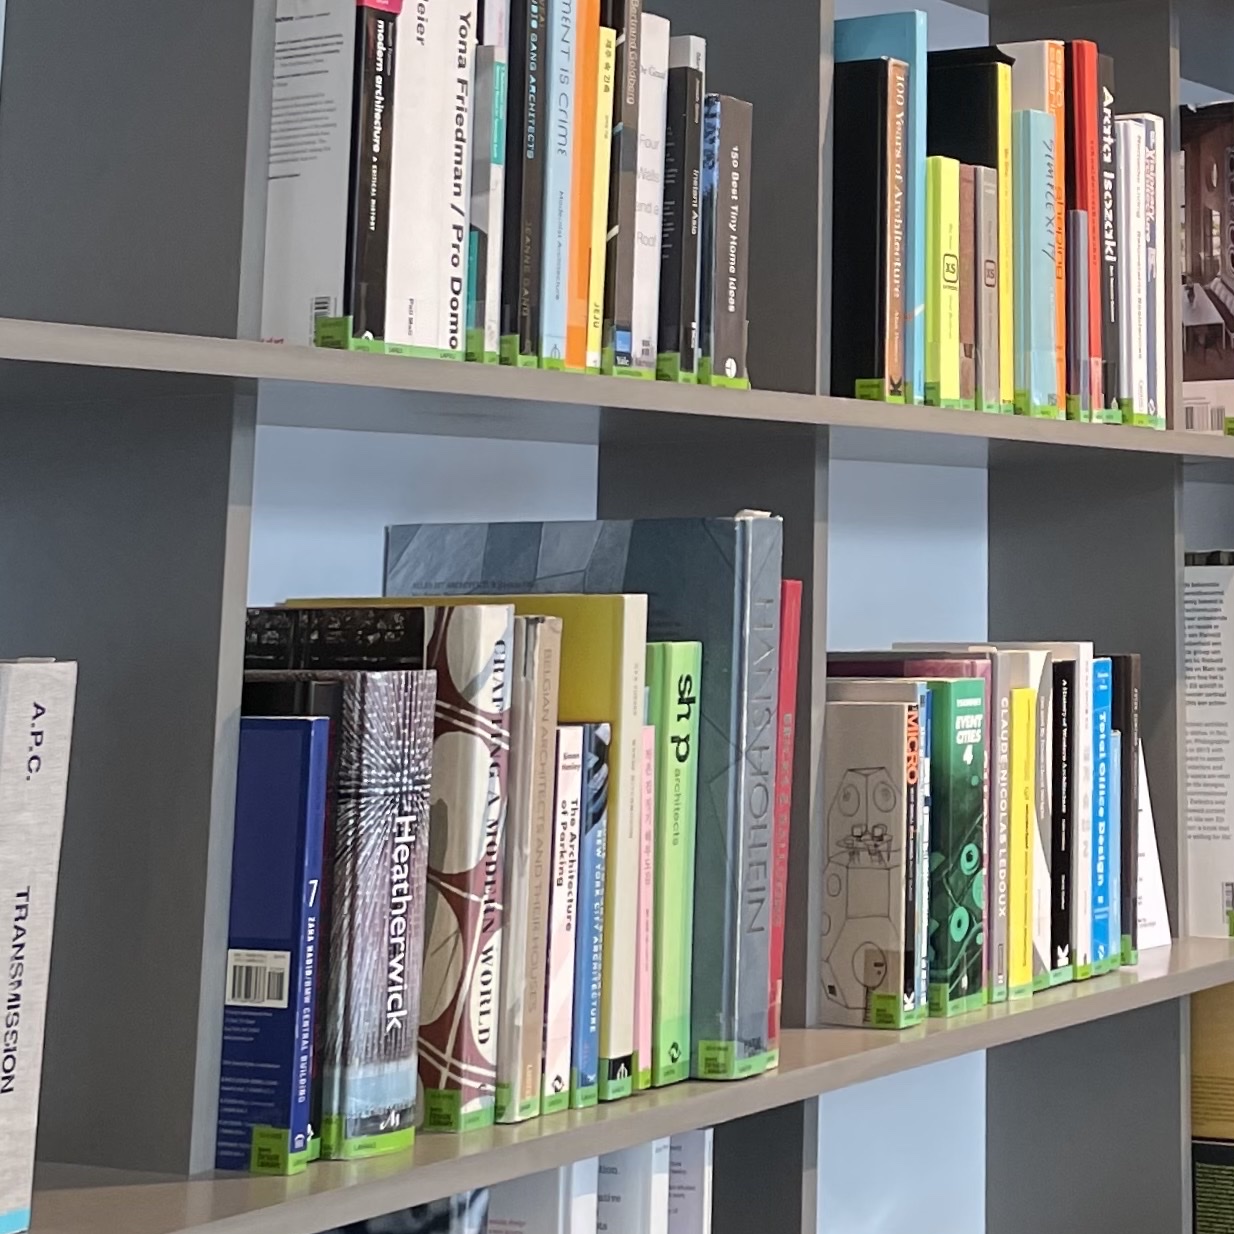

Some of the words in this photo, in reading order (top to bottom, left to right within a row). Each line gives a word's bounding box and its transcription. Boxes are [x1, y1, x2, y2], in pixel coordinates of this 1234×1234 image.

[375, 19, 386, 73] modern
[457, 11, 473, 70] Yona
[528, 32, 539, 71] GANG
[559, 69, 571, 88] IS
[626, 50, 638, 105] Goldberg
[895, 74, 906, 106] 100
[371, 75, 384, 154] architecture
[452, 77, 469, 198] Friedman
[525, 72, 538, 160] ARCHITECTS
[895, 109, 905, 159] Years
[1102, 85, 1116, 164] Arata
[731, 144, 740, 168] 150
[894, 164, 904, 185] of
[691, 169, 700, 209] Instant
[730, 171, 740, 200] Best
[690, 210, 698, 236] Asia
[729, 204, 740, 232] Tiny
[1102, 171, 1117, 263] Isozaki
[450, 224, 466, 270] Pro
[728, 235, 738, 273] Home
[892, 188, 904, 299] Architecture
[447, 276, 462, 351] Domo
[593, 302, 602, 329] JEJU
[727, 276, 737, 313] Ideas
[541, 648, 553, 722] BELGIAN
[750, 598, 774, 727] HANS
[489, 639, 507, 779] CRAFTING
[955, 714, 982, 731] EVENT
[1099, 711, 1107, 758] Total
[25, 701, 46, 783] A.P.C.
[906, 710, 919, 786] MICRO
[956, 729, 982, 745] CITIES
[962, 744, 974, 766] 4
[488, 792, 502, 808] A
[536, 725, 550, 829] ARCHITECTS
[1098, 761, 1106, 818] Office
[561, 798, 569, 817] of
[569, 797, 579, 823] The
[671, 767, 682, 847] architects
[535, 832, 546, 873] AND
[555, 820, 567, 888] Parking
[595, 829, 603, 857] NEW
[746, 745, 770, 934] HOLLEIN
[1097, 821, 1105, 887] Design
[307, 879, 319, 908] 7
[480, 815, 501, 935] MODERN
[565, 825, 578, 932] Architecture
[593, 863, 602, 897] YORK
[998, 848, 1007, 917] LEDOUX
[306, 917, 316, 943] ZAHA
[385, 814, 417, 1033] Heatherwick
[532, 879, 543, 931] THEIR
[592, 901, 601, 931] CITY
[0, 884, 31, 1095] TRANSMISSION
[477, 945, 493, 1046] WORLD
[527, 935, 541, 1013] HOUSES
[588, 935, 599, 1034] ARCHITECTURE
[299, 1007, 311, 1052] CENTRAL
[296, 1055, 308, 1103] BUILDING
